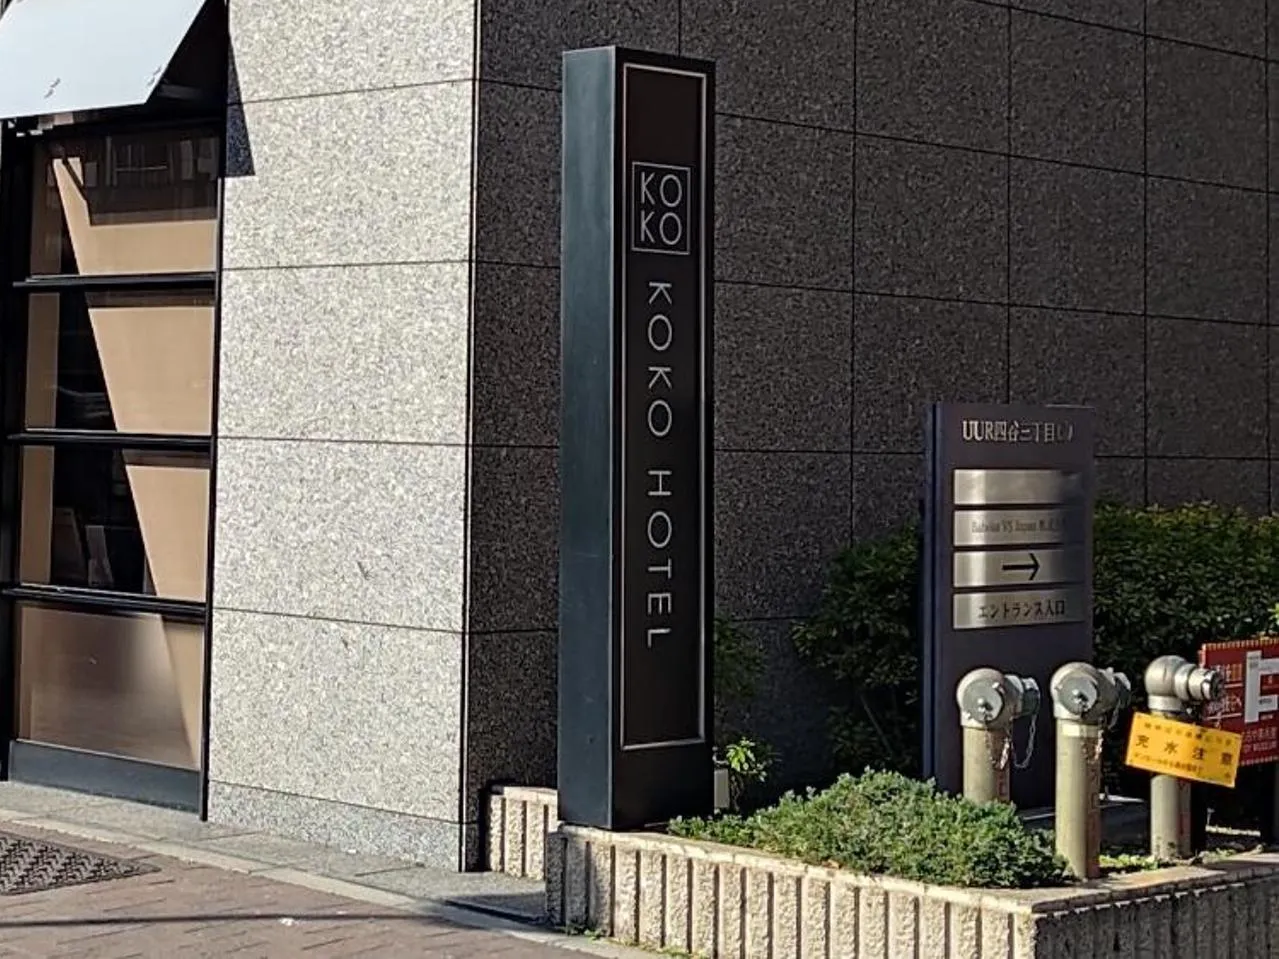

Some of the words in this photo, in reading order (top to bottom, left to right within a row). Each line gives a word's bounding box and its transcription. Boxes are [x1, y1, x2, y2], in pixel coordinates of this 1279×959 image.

[640, 171, 683, 208] KO
[640, 210, 683, 246] KO
[647, 281, 673, 437] KOKO
[647, 469, 673, 648] HOTEL
